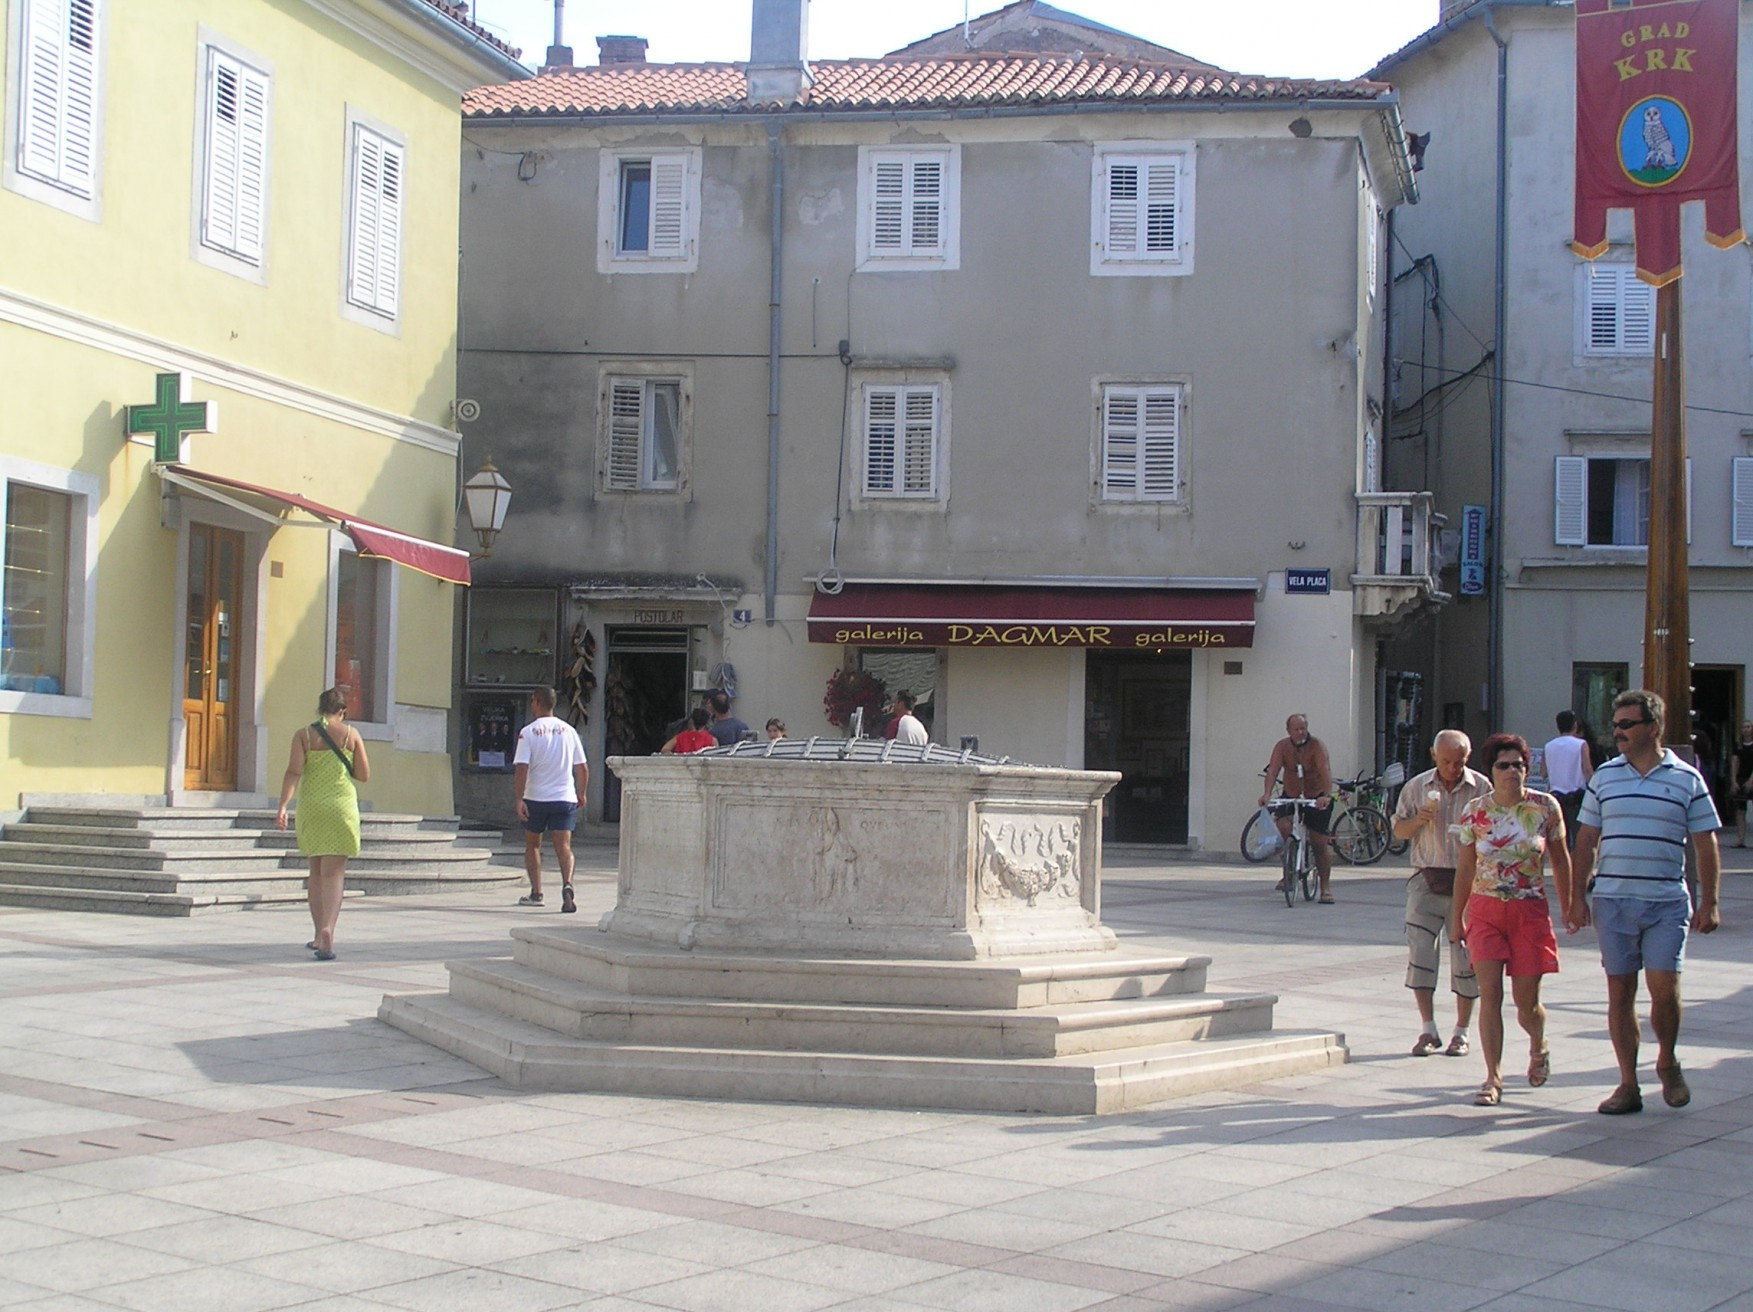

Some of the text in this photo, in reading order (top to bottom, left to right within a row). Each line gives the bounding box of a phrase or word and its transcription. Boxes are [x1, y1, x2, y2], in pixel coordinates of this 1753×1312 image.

[1621, 21, 1690, 47] GRAD
[1613, 48, 1696, 81] KRK
[1289, 576, 1327, 586] VELA PLACA
[634, 609, 684, 623] POSTOLAR
[738, 610, 746, 622] 4
[835, 624, 1226, 647] galerija DAGMAR galerija
